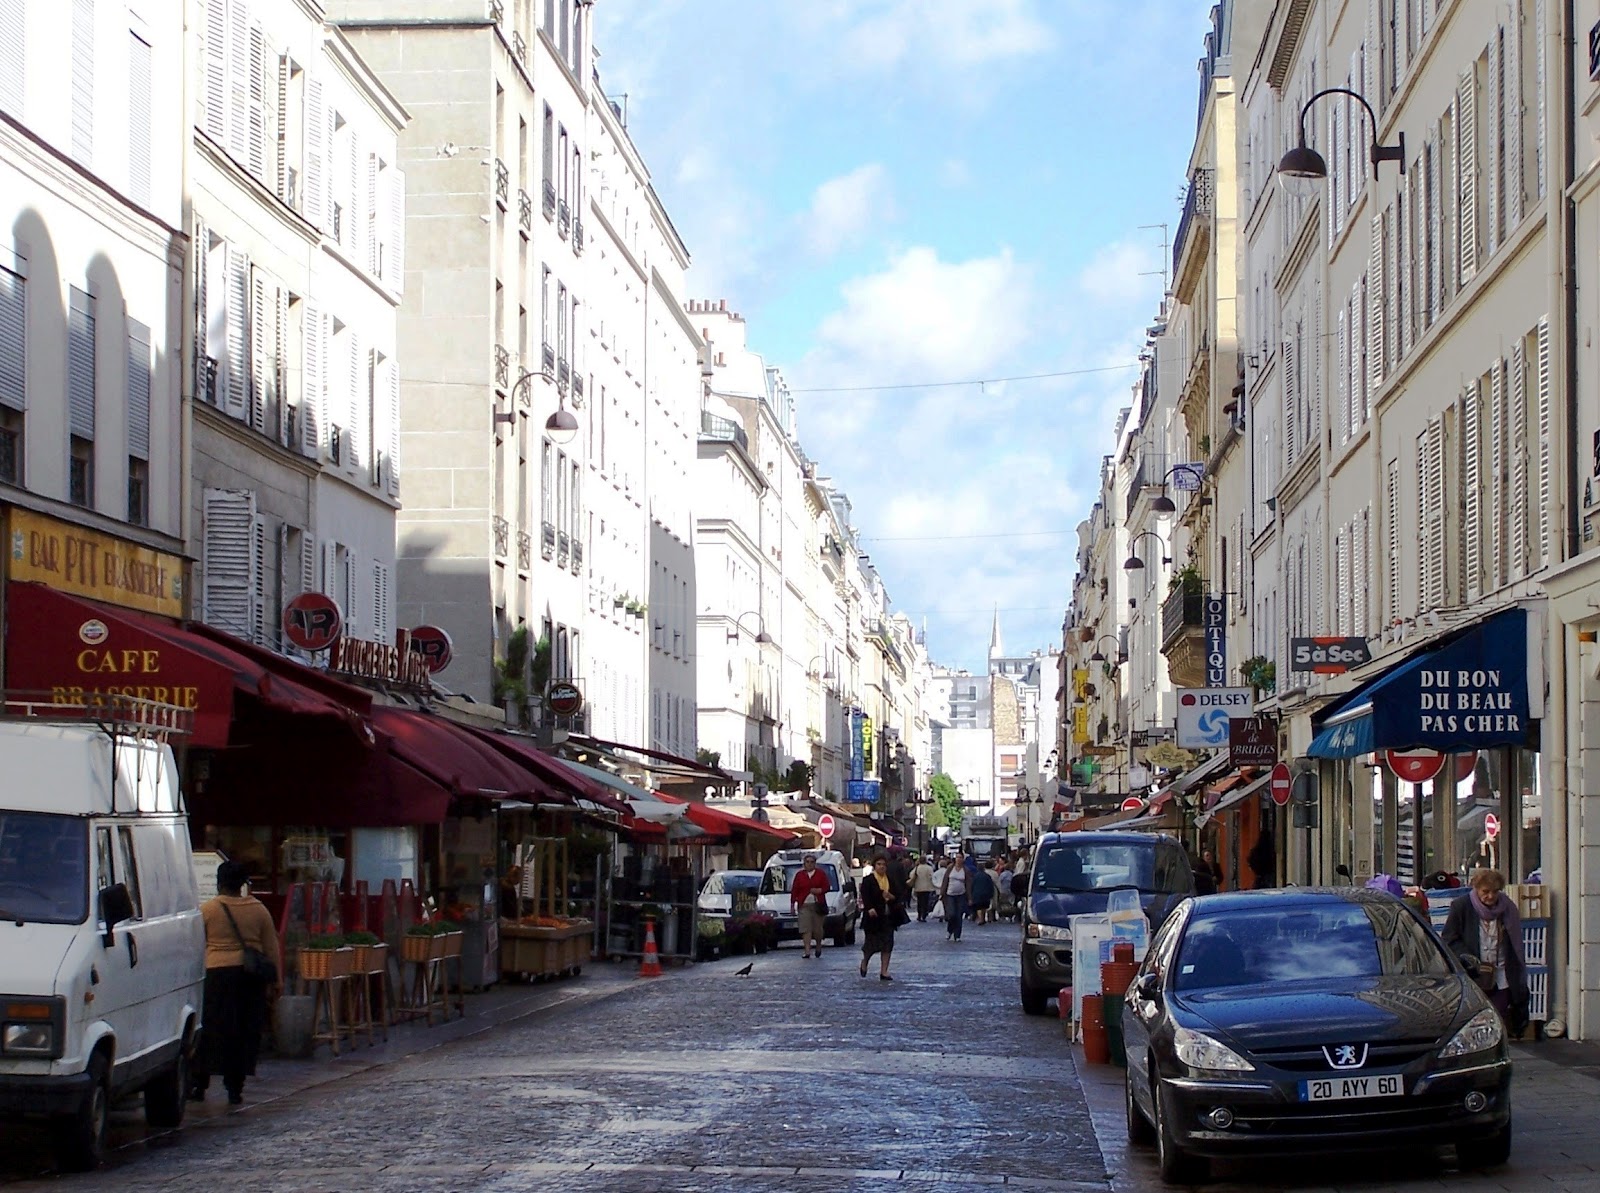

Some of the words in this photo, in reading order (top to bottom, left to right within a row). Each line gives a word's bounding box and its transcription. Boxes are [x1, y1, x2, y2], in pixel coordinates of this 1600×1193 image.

[30, 530, 60, 574] BAR
[1208, 600, 1224, 687] OPTIQU
[77, 650, 160, 673] CAFE
[1295, 646, 1311, 663] 5
[1312, 646, 1326, 662] à
[1328, 645, 1363, 663] Sec
[1420, 670, 1450, 688] DU
[1457, 670, 1500, 688] BON
[1200, 693, 1250, 706] DELSEY
[1420, 693, 1450, 710] DU
[1457, 692, 1511, 710] BEAU
[1421, 715, 1458, 732] PAS
[1464, 714, 1520, 732] CHER
[1231, 745, 1276, 757] BRUGES
[1313, 1081, 1332, 1099] 20
[1342, 1079, 1369, 1097] AYY
[1378, 1077, 1398, 1094] 60
